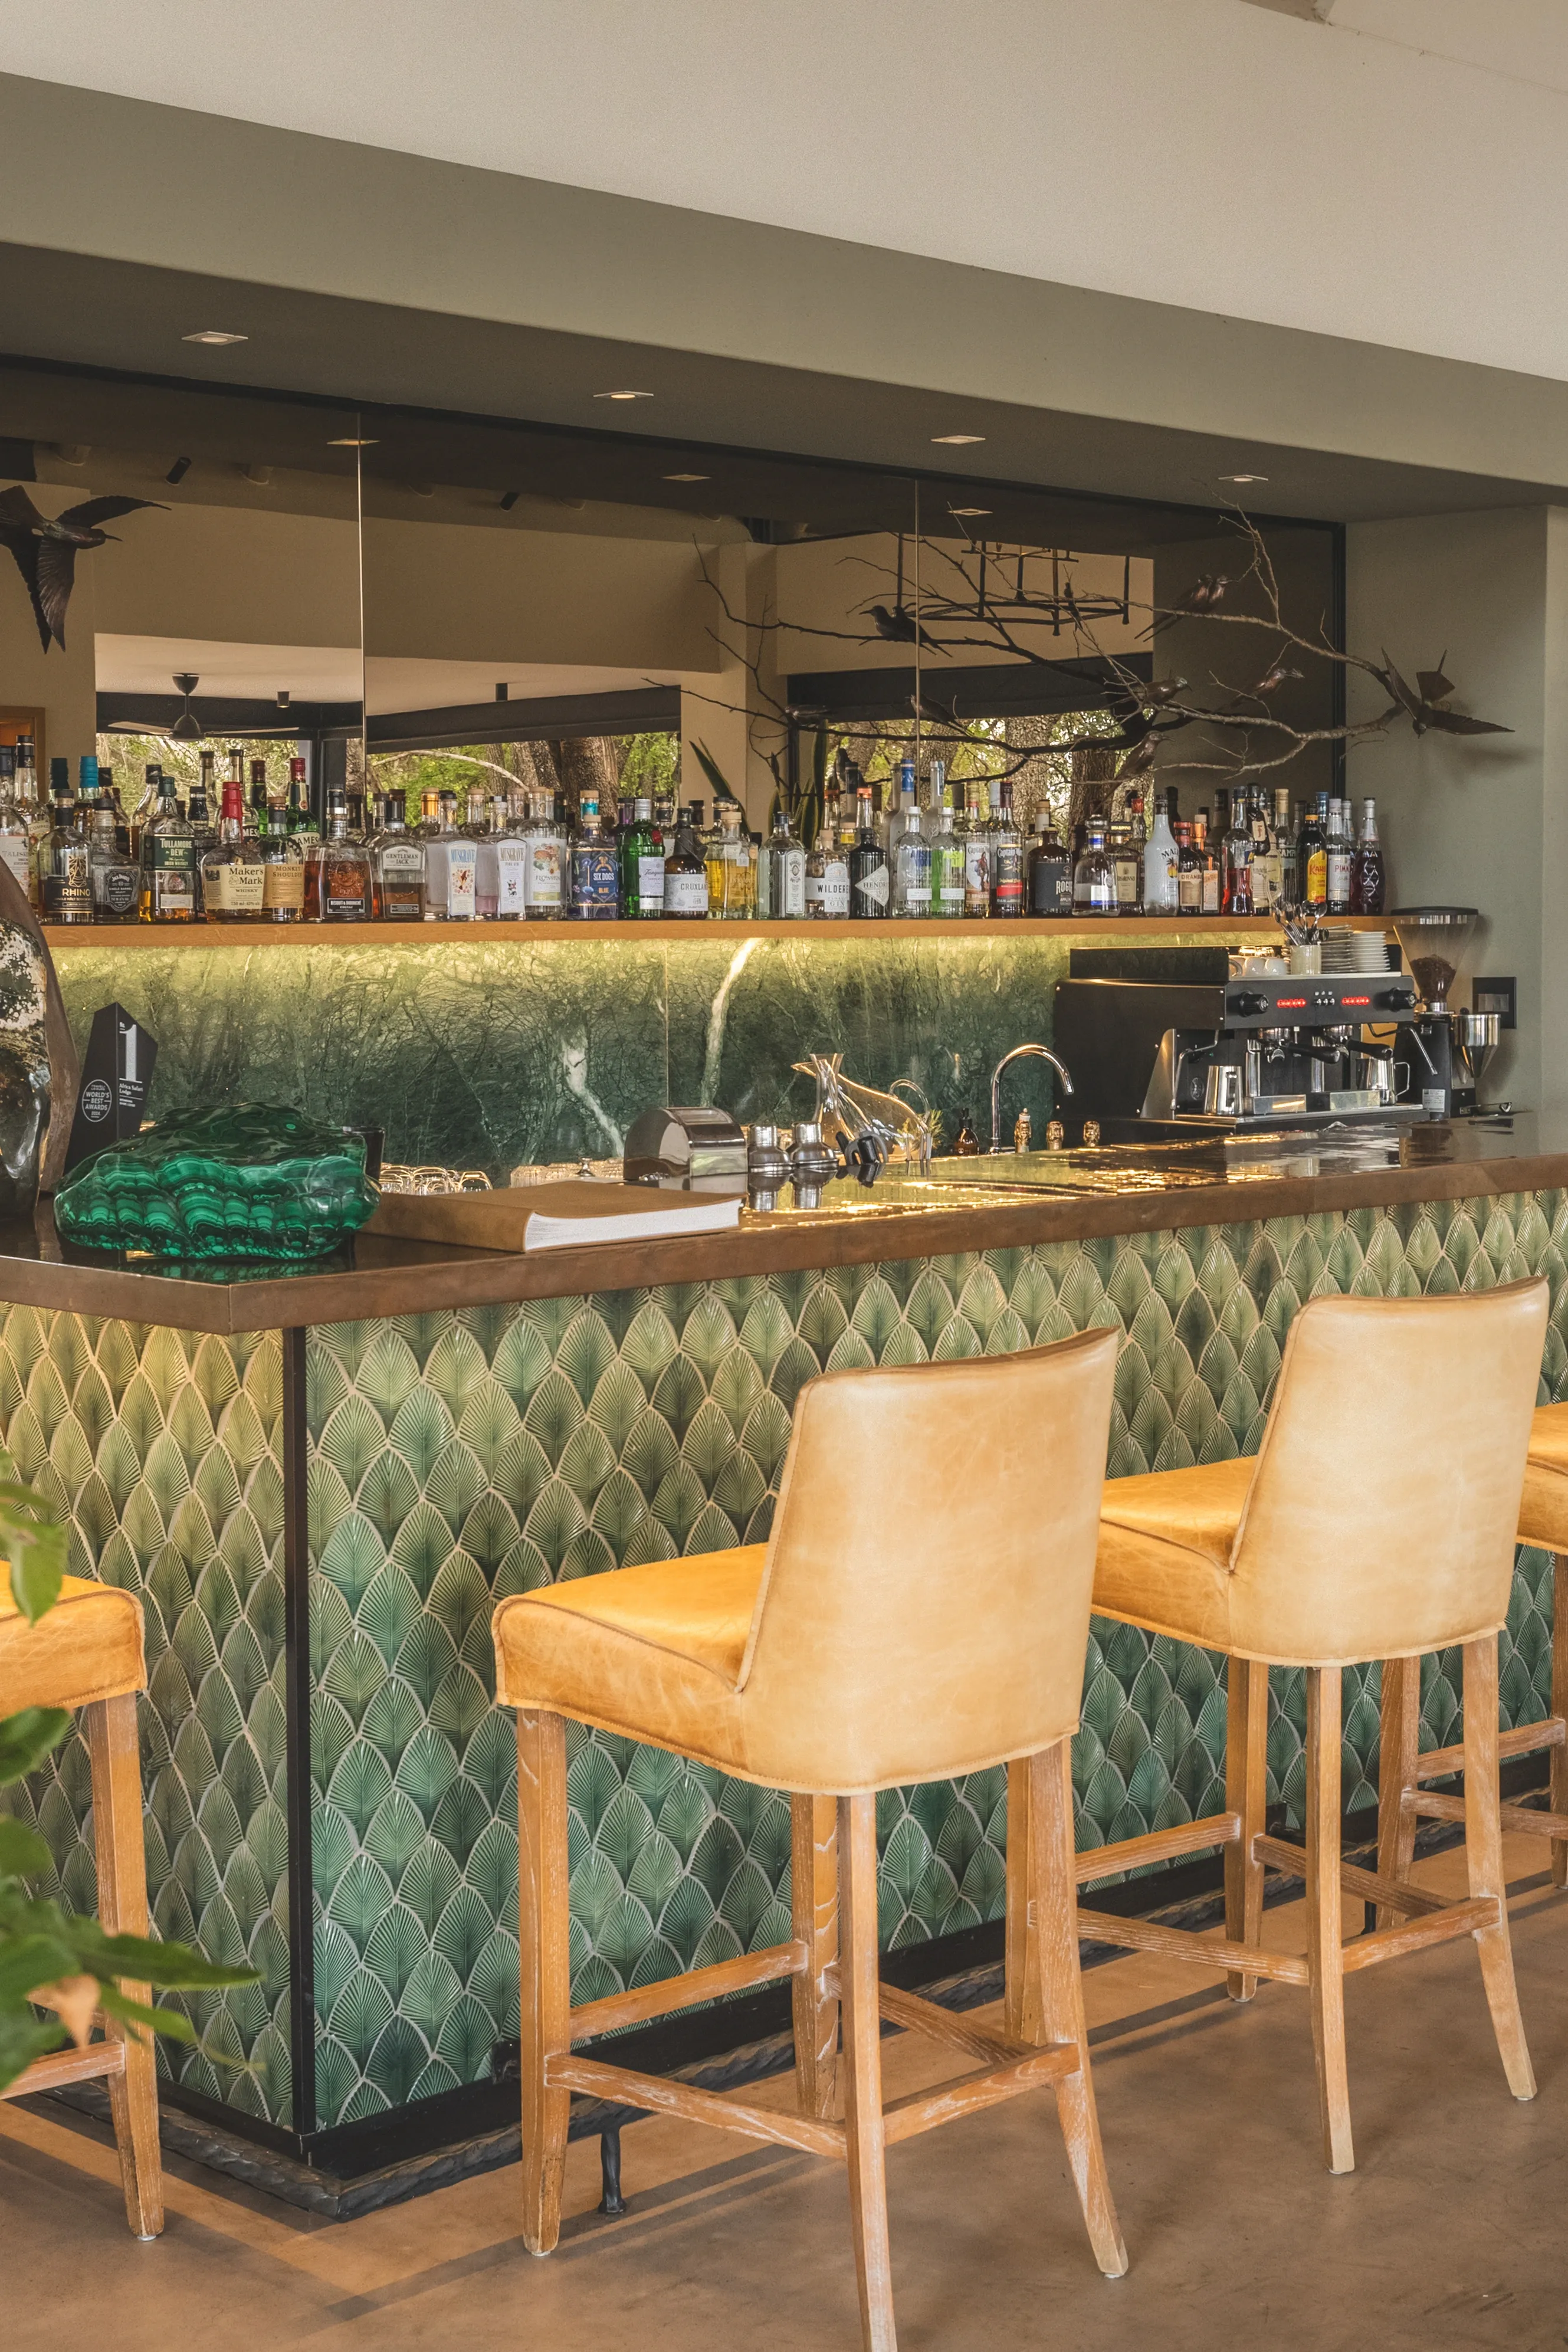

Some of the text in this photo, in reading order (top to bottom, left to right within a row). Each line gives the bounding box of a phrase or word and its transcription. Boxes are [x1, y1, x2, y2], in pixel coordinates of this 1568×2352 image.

[160, 838, 192, 849] TULLAMORE
[500, 848, 524, 861] MUSGRAVE
[239, 877, 263, 885] Mark
[593, 872, 615, 881] SIX DOGS
[61, 888, 91, 897] RHINO
